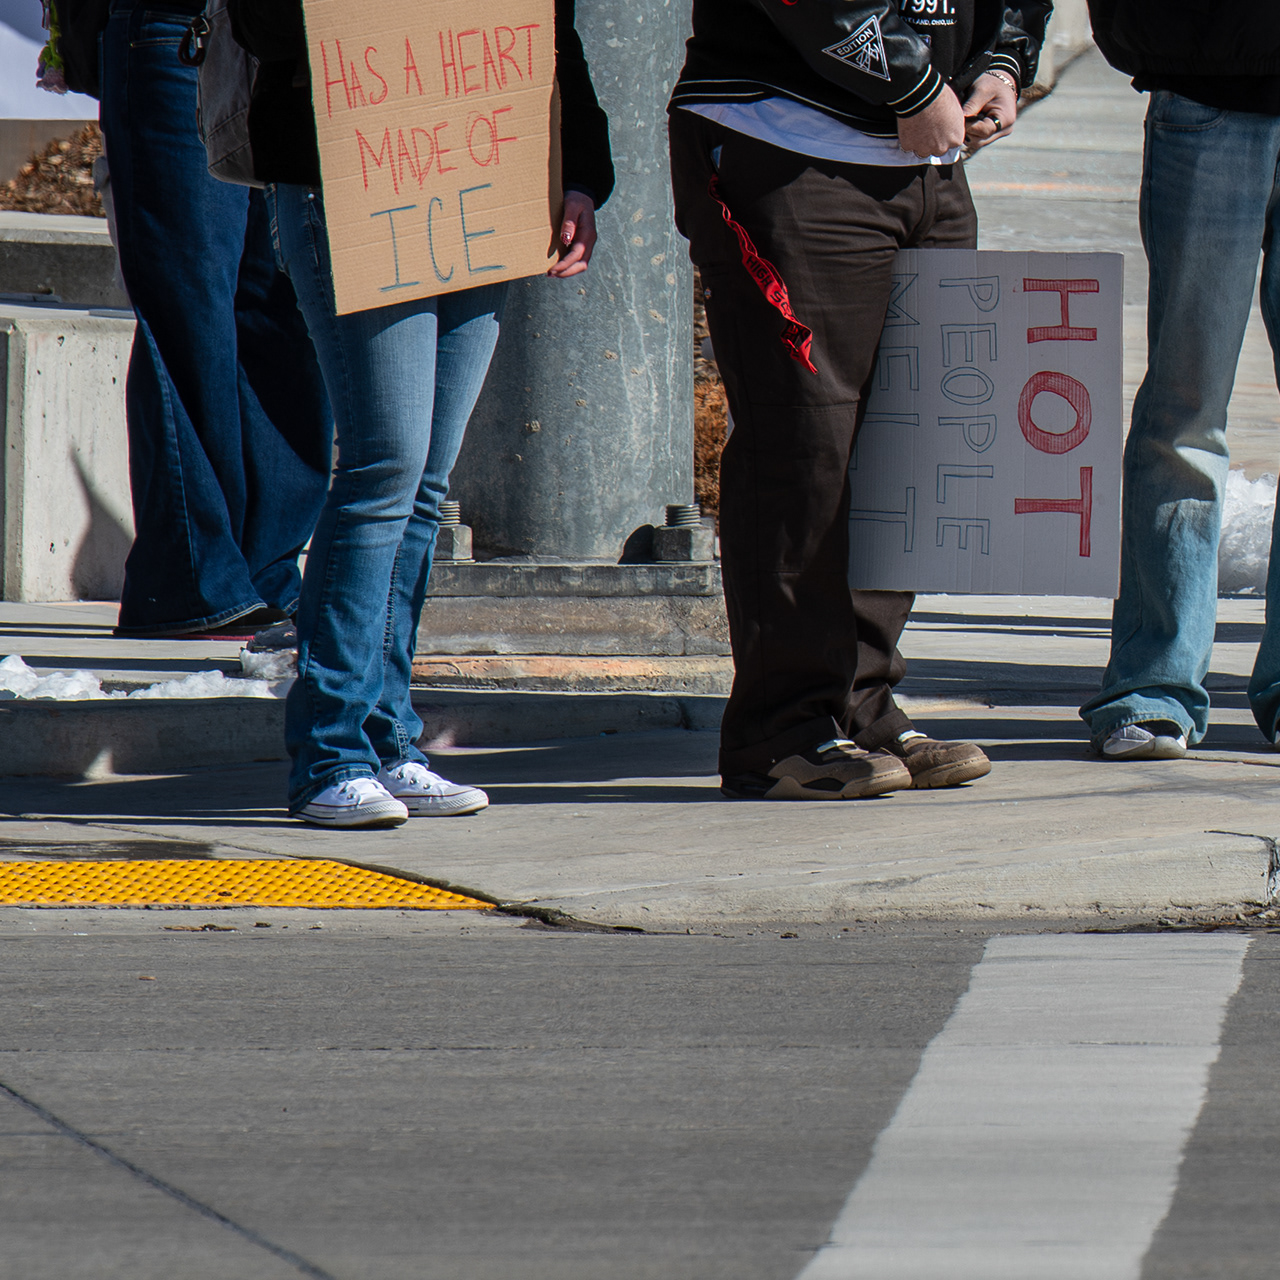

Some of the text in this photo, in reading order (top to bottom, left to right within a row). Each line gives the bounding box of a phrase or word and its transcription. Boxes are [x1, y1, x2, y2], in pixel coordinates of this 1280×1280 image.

[404, 36, 426, 96] A
[439, 24, 540, 99] HEART
[837, 27, 874, 56] EDITION
[355, 106, 518, 195] MADE OF
[370, 183, 506, 291] ICE
[746, 253, 773, 289] HIGH
[936, 275, 1000, 556] PEOPLE
[1014, 277, 1100, 558] HOT
